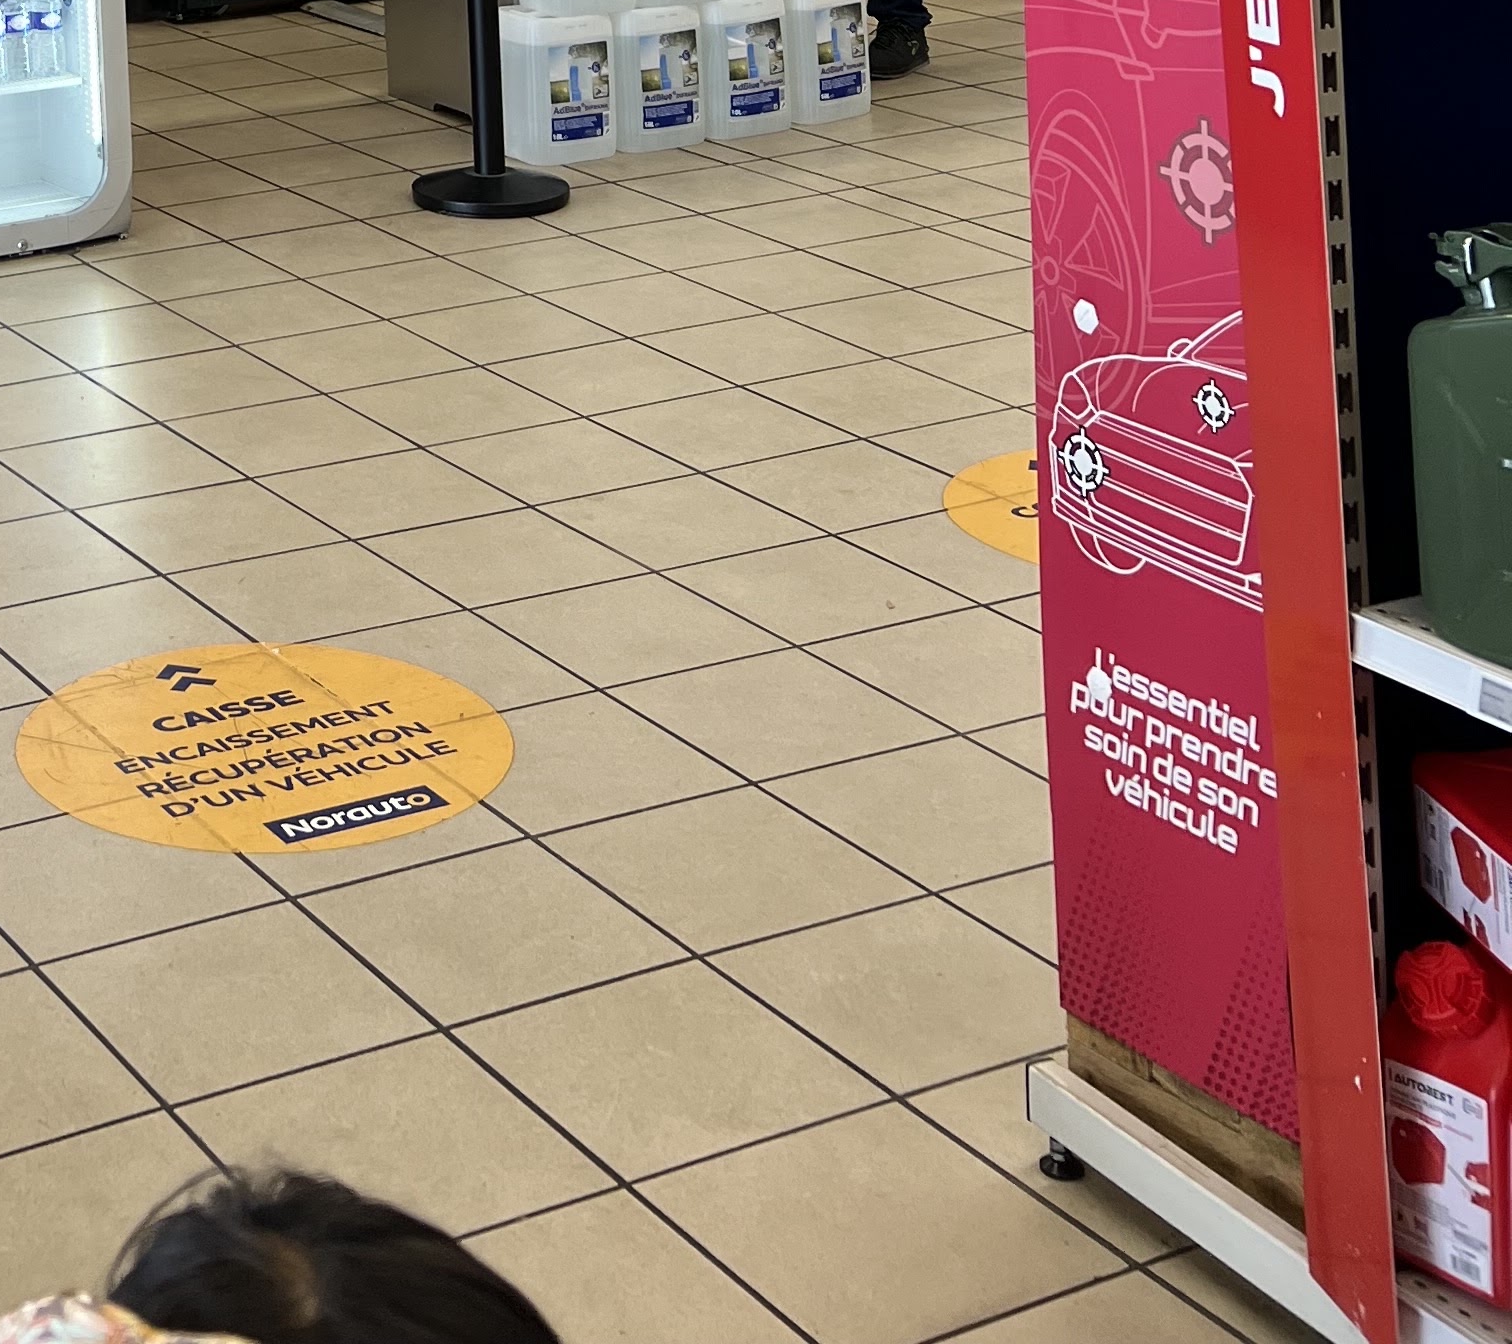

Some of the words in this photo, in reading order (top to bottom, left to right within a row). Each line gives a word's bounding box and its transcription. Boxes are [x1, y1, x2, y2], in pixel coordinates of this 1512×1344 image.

[114, 701, 397, 775] ENCAISSEMENT
[153, 690, 304, 732] CAISSE
[1071, 681, 1144, 731] pour
[1145, 715, 1278, 798] prendre
[137, 721, 433, 799] RÉCUPÉRATION
[161, 783, 264, 818] D'UN
[268, 740, 457, 804] VÉHICULE
[1084, 724, 1147, 774] soin
[1153, 753, 1193, 795] de
[1197, 777, 1259, 828] son
[280, 791, 433, 837] Norauto
[1105, 769, 1238, 854] véhicule
[1394, 1073, 1454, 1106] AUTOBEST
